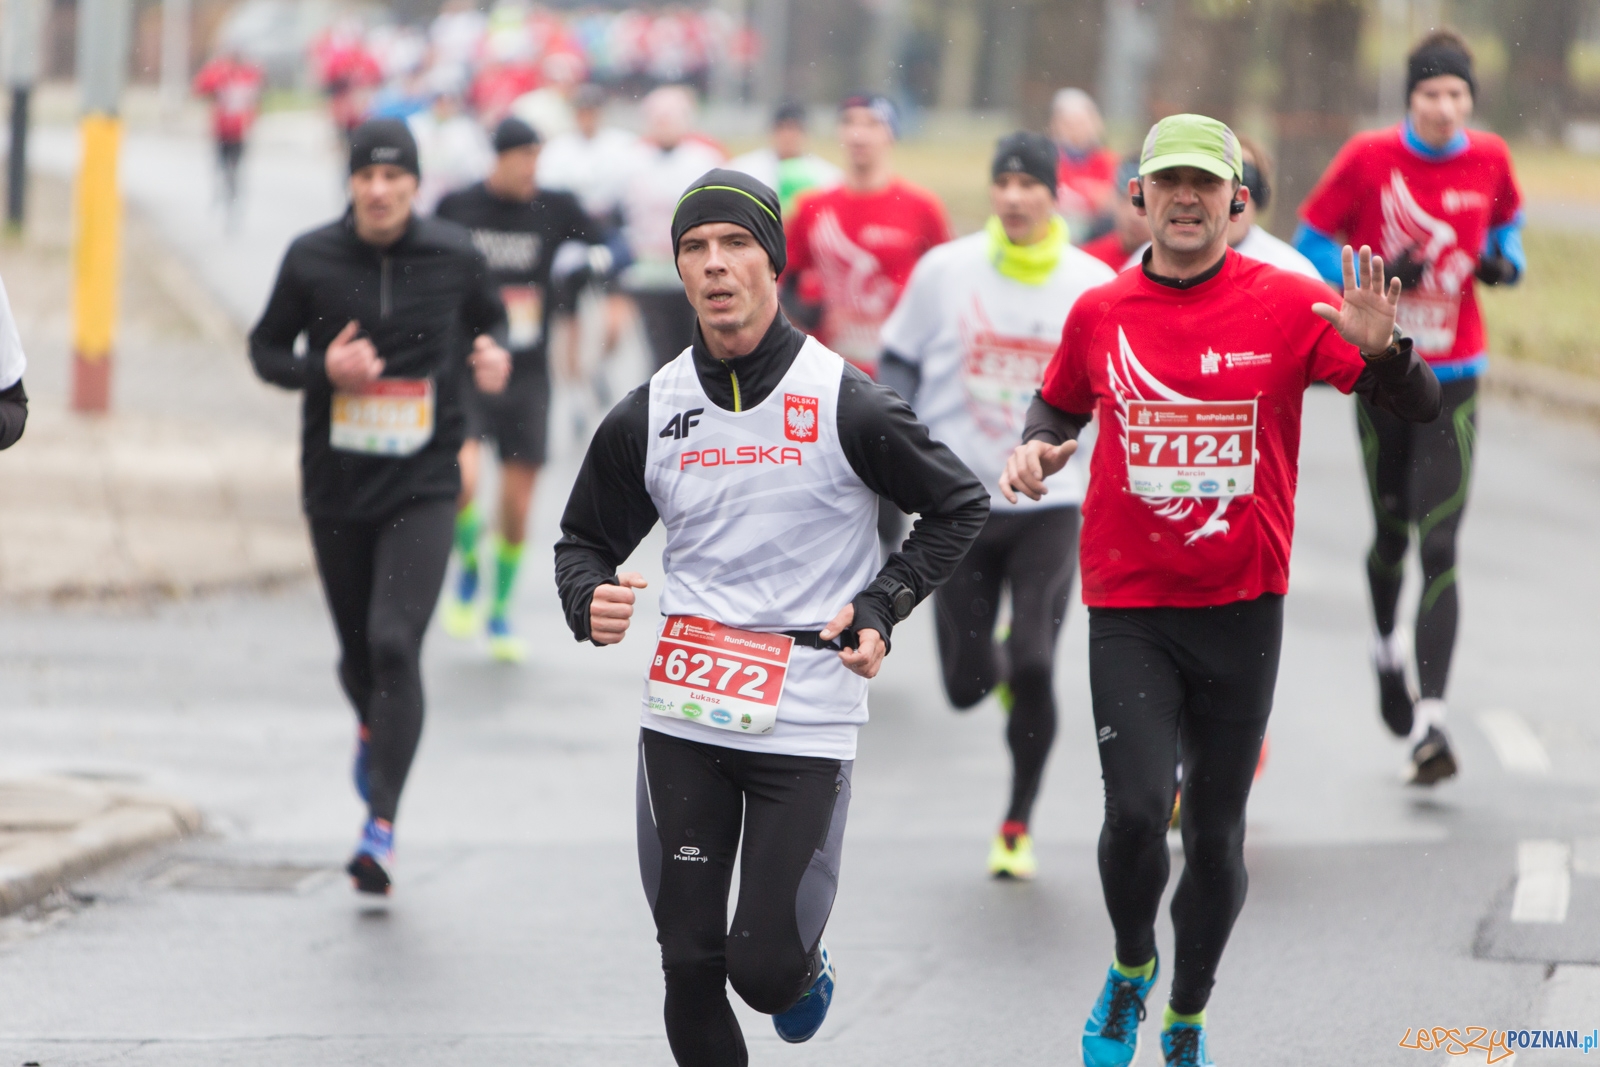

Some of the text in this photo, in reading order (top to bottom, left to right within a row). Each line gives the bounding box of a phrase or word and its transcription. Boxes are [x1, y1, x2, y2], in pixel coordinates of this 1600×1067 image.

[1225, 352, 1234, 367] 1
[786, 395, 816, 405] POLSKA
[659, 408, 704, 440] 4F
[1196, 413, 1248, 422] RunPoland.org
[1131, 434, 1243, 465] B 7124
[680, 446, 802, 471] POLSKA
[724, 635, 781, 655] RunPoland.org
[654, 649, 769, 700] B 6272
[690, 692, 721, 705] Łukasz
[674, 854, 708, 863] Kalenji
